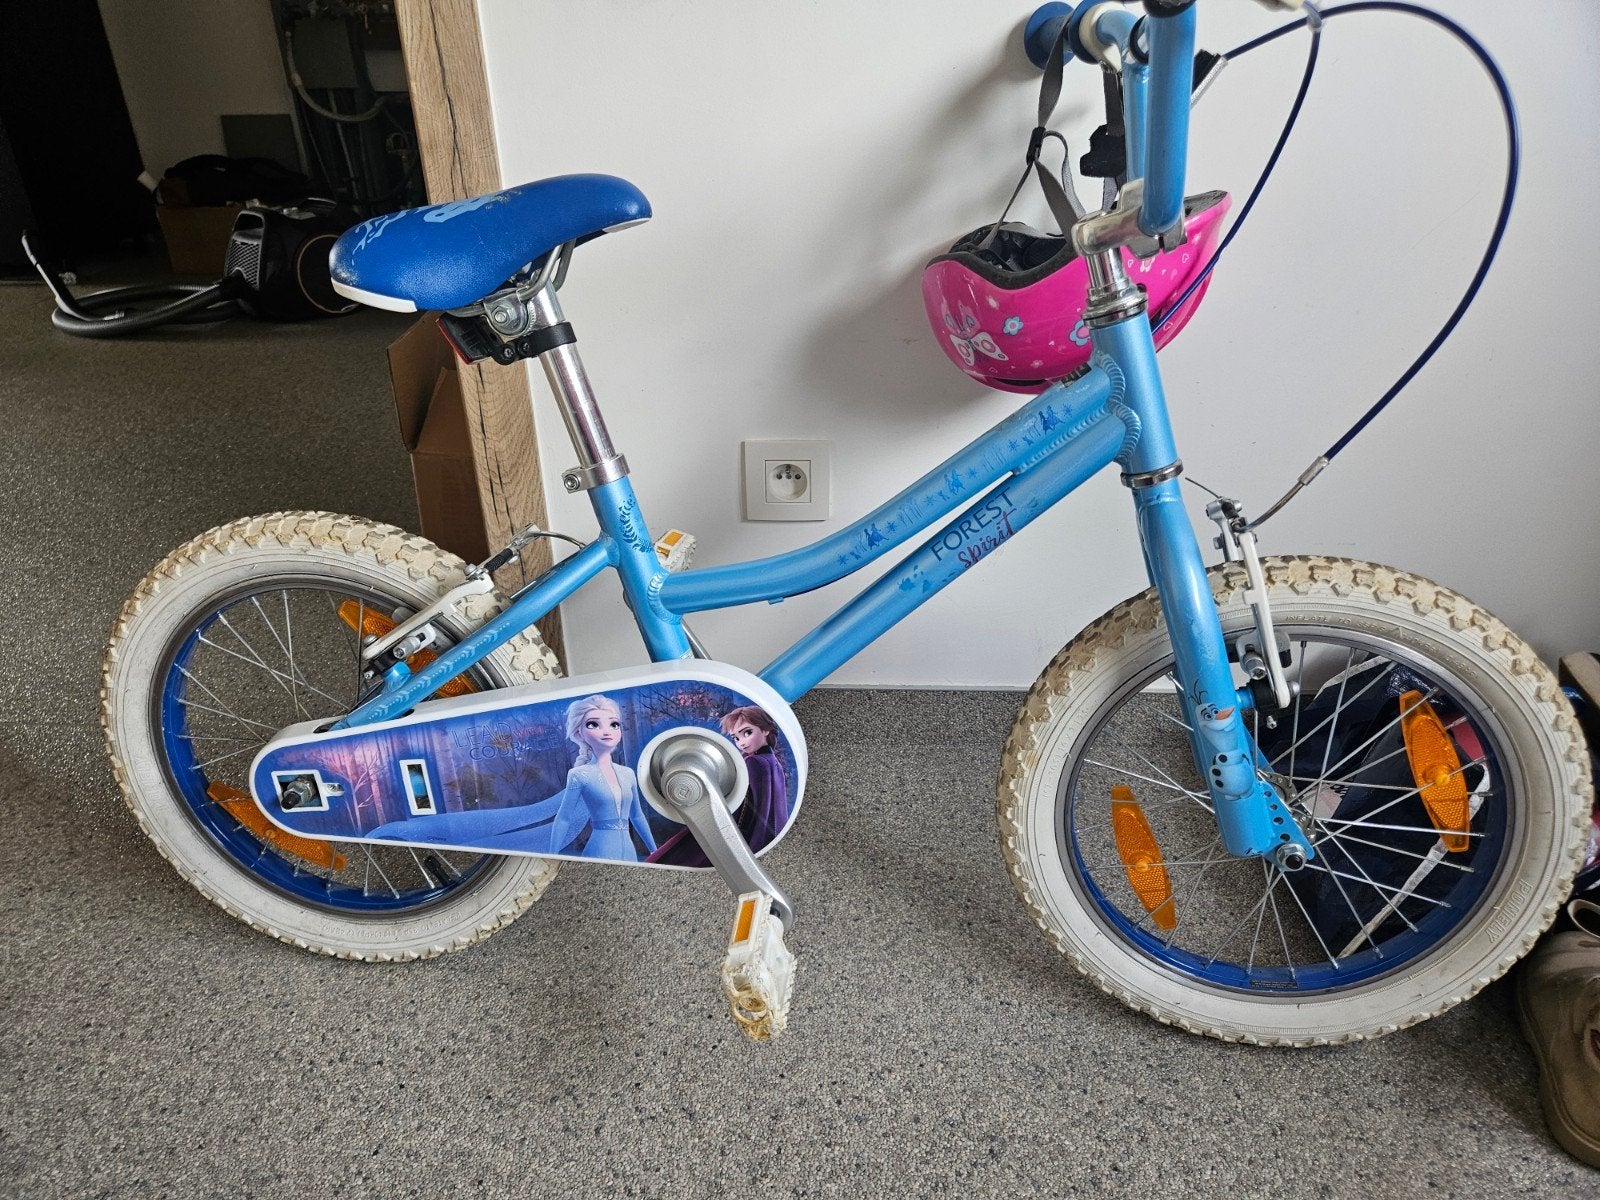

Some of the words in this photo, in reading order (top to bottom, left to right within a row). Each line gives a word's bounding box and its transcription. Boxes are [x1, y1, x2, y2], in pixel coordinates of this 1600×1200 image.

[930, 486, 1014, 562] FOREST
[957, 507, 1017, 569] spirit
[451, 721, 513, 749] LEAD
[1484, 878, 1534, 944] PONELY
